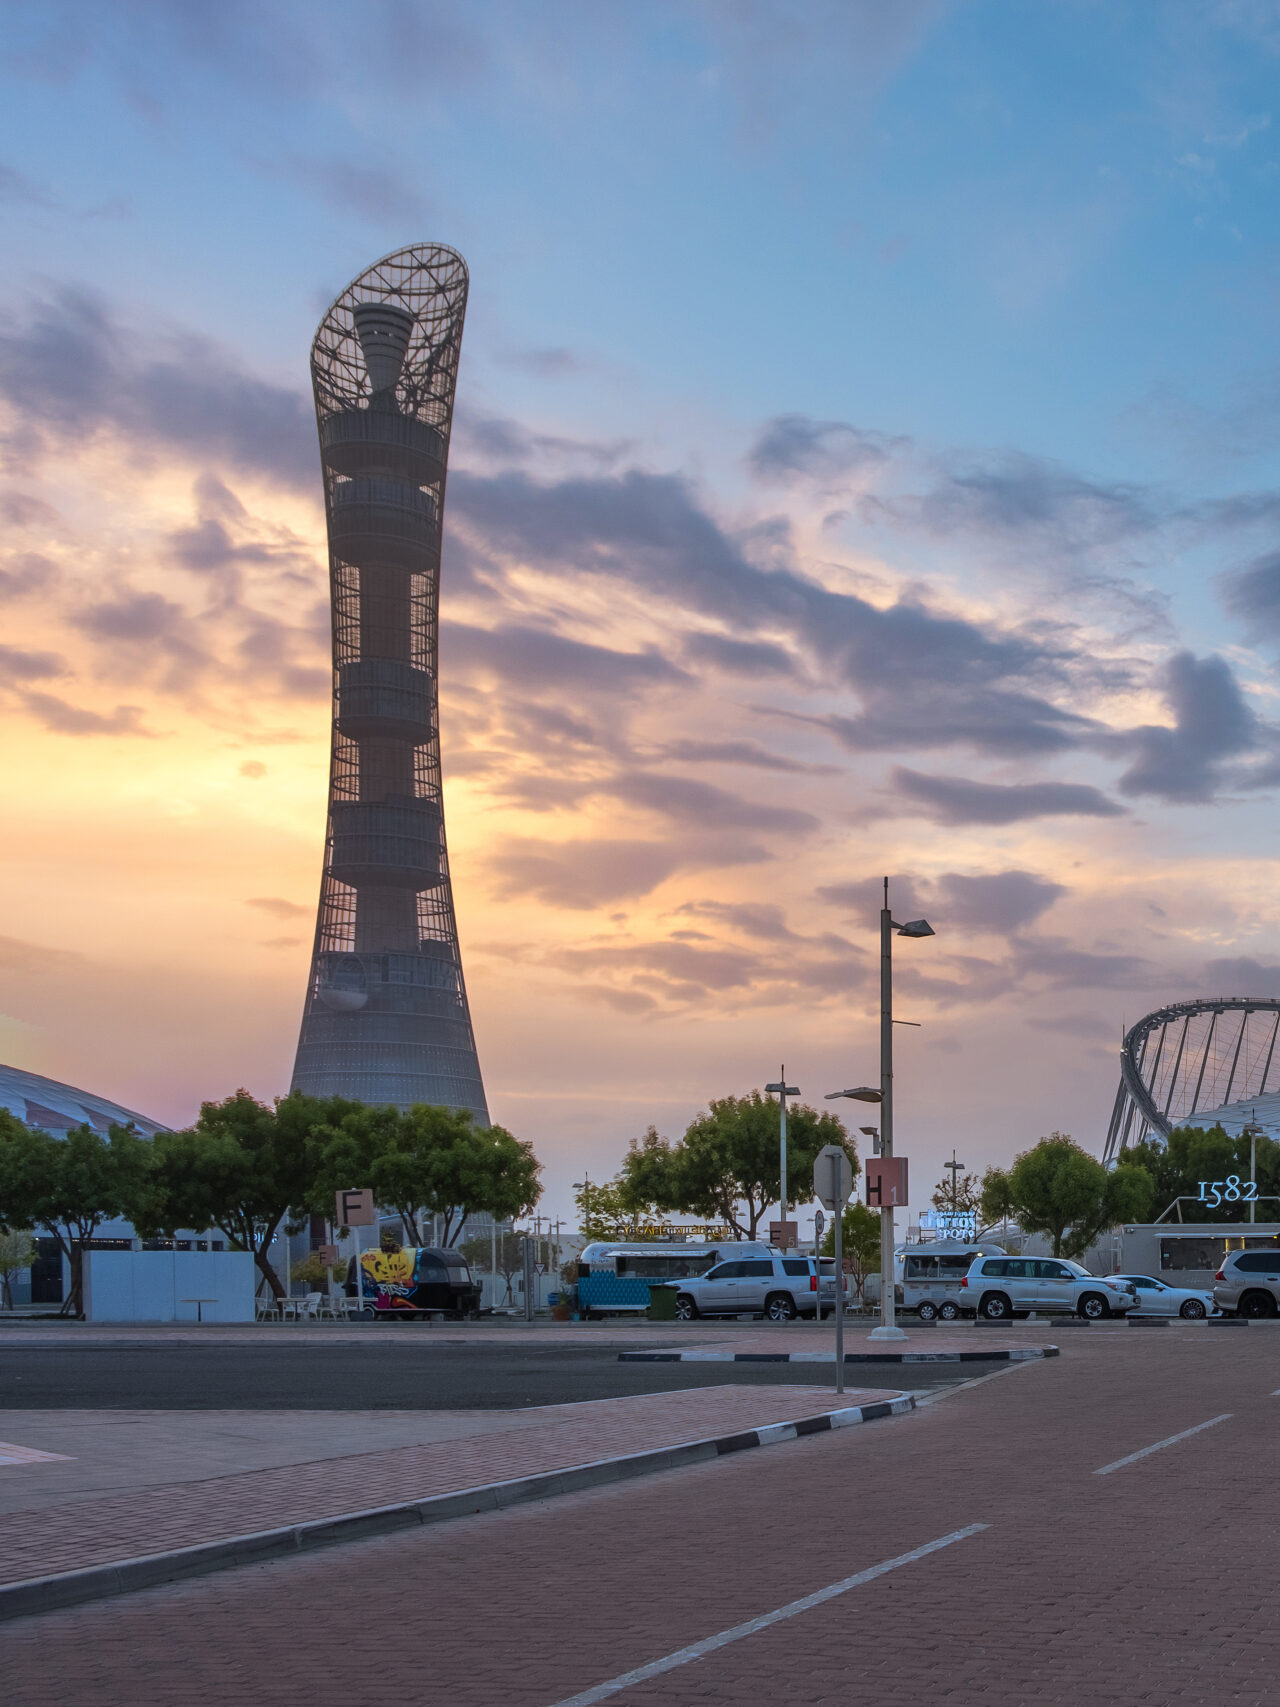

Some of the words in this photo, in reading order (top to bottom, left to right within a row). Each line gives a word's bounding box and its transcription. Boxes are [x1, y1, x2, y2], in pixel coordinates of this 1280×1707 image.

[866, 1175, 882, 1205] H
[890, 1185, 899, 1205] 1
[1197, 1174, 1259, 1208] 1582
[342, 1191, 363, 1225] F
[787, 1236, 795, 1247] 5
[319, 1251, 327, 1265] F
